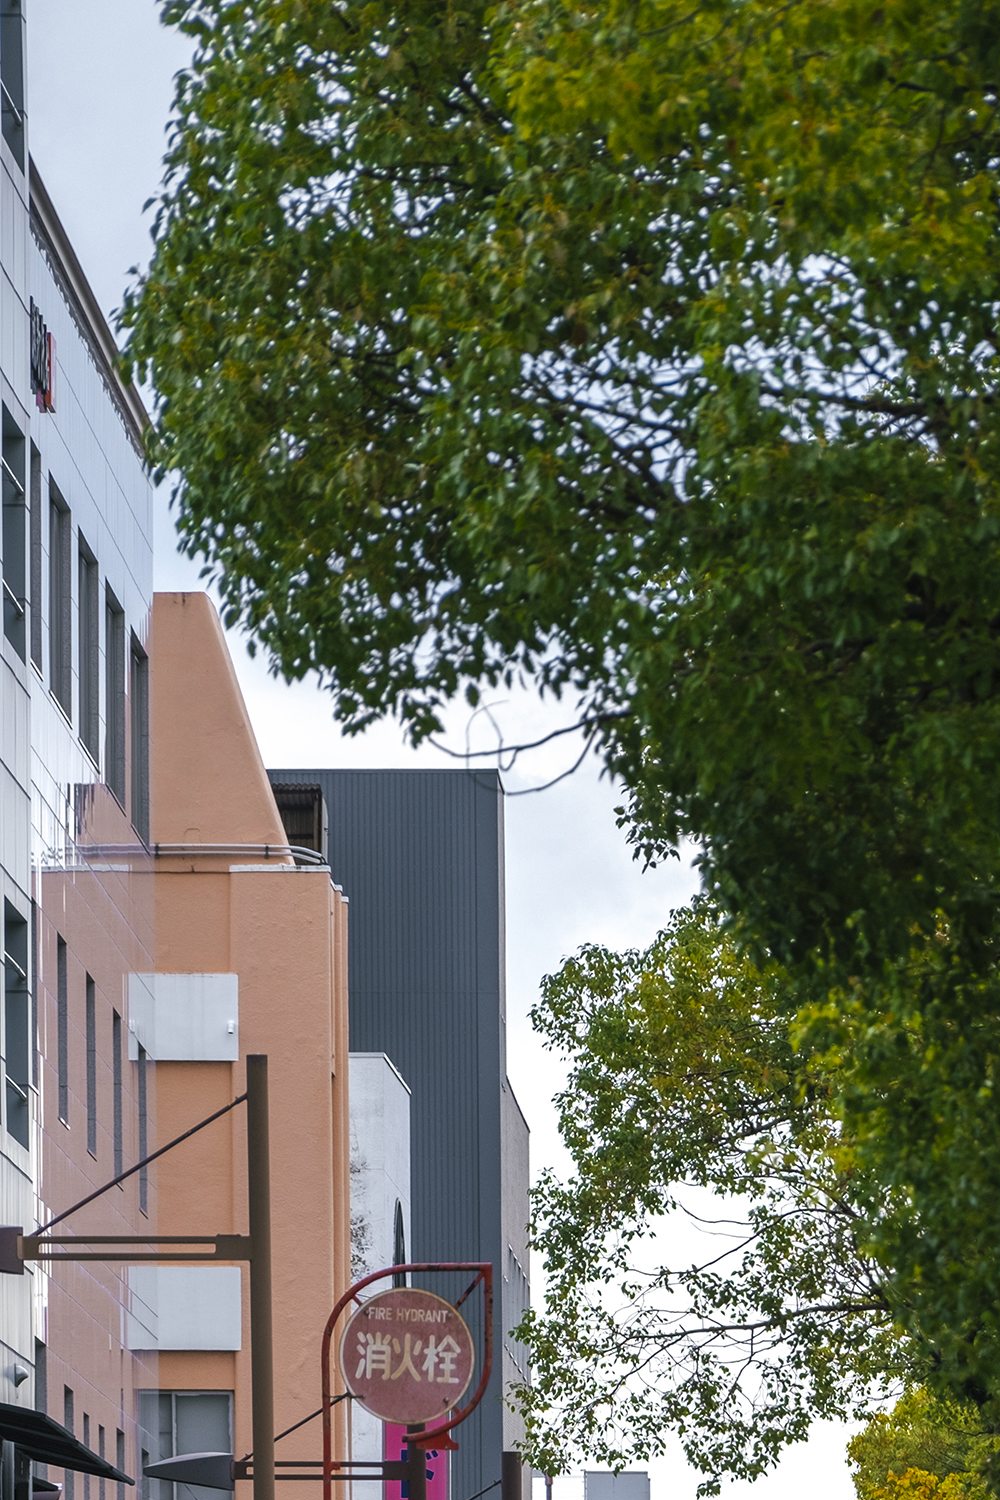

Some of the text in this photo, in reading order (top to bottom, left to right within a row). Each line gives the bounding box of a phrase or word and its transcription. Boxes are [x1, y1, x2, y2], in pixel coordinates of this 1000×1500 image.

[367, 1306, 449, 1323] FIRE HYDRANT
[355, 1331, 461, 1384] 消火栓
